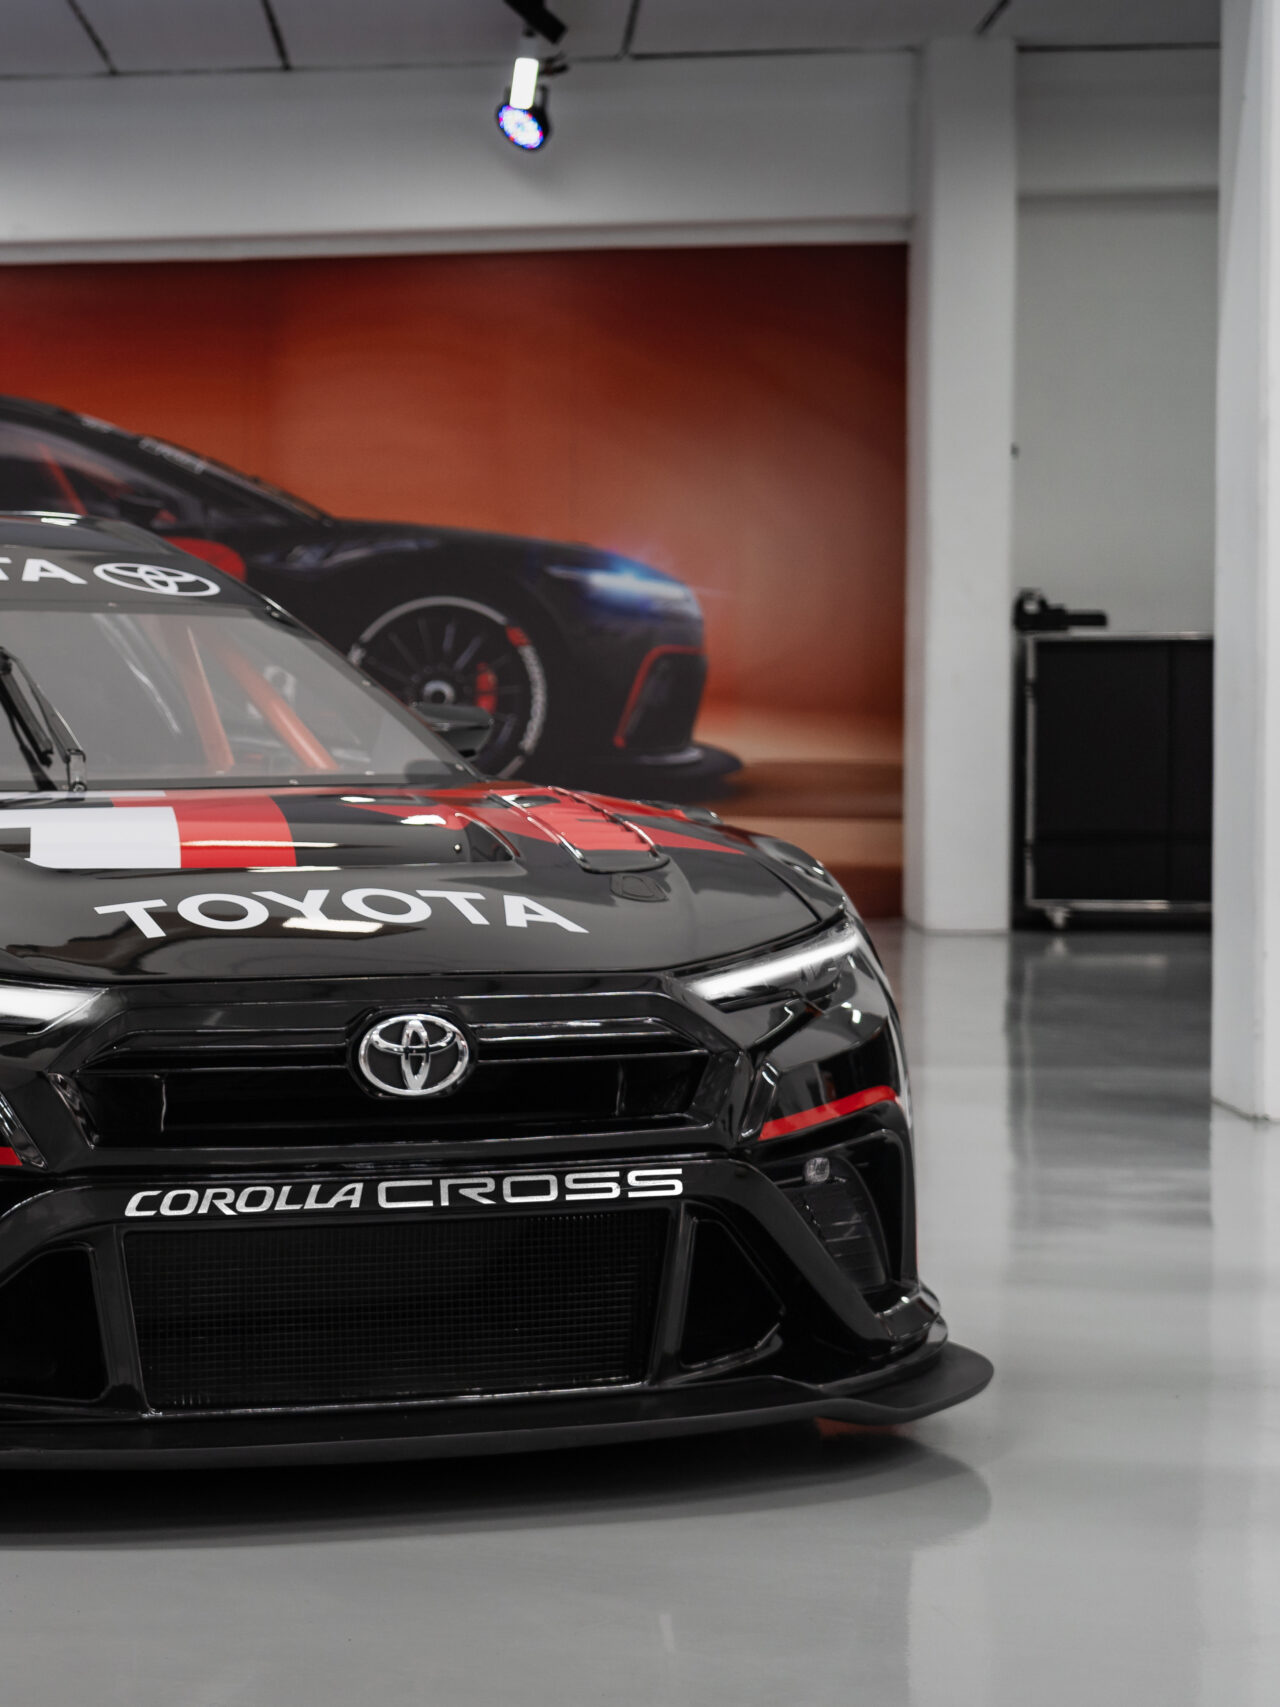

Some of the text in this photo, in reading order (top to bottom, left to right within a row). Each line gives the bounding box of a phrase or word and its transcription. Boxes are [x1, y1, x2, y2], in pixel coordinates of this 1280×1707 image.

[94, 888, 590, 939] TOYOTA
[124, 1168, 684, 1217] COROLLA CROSS
